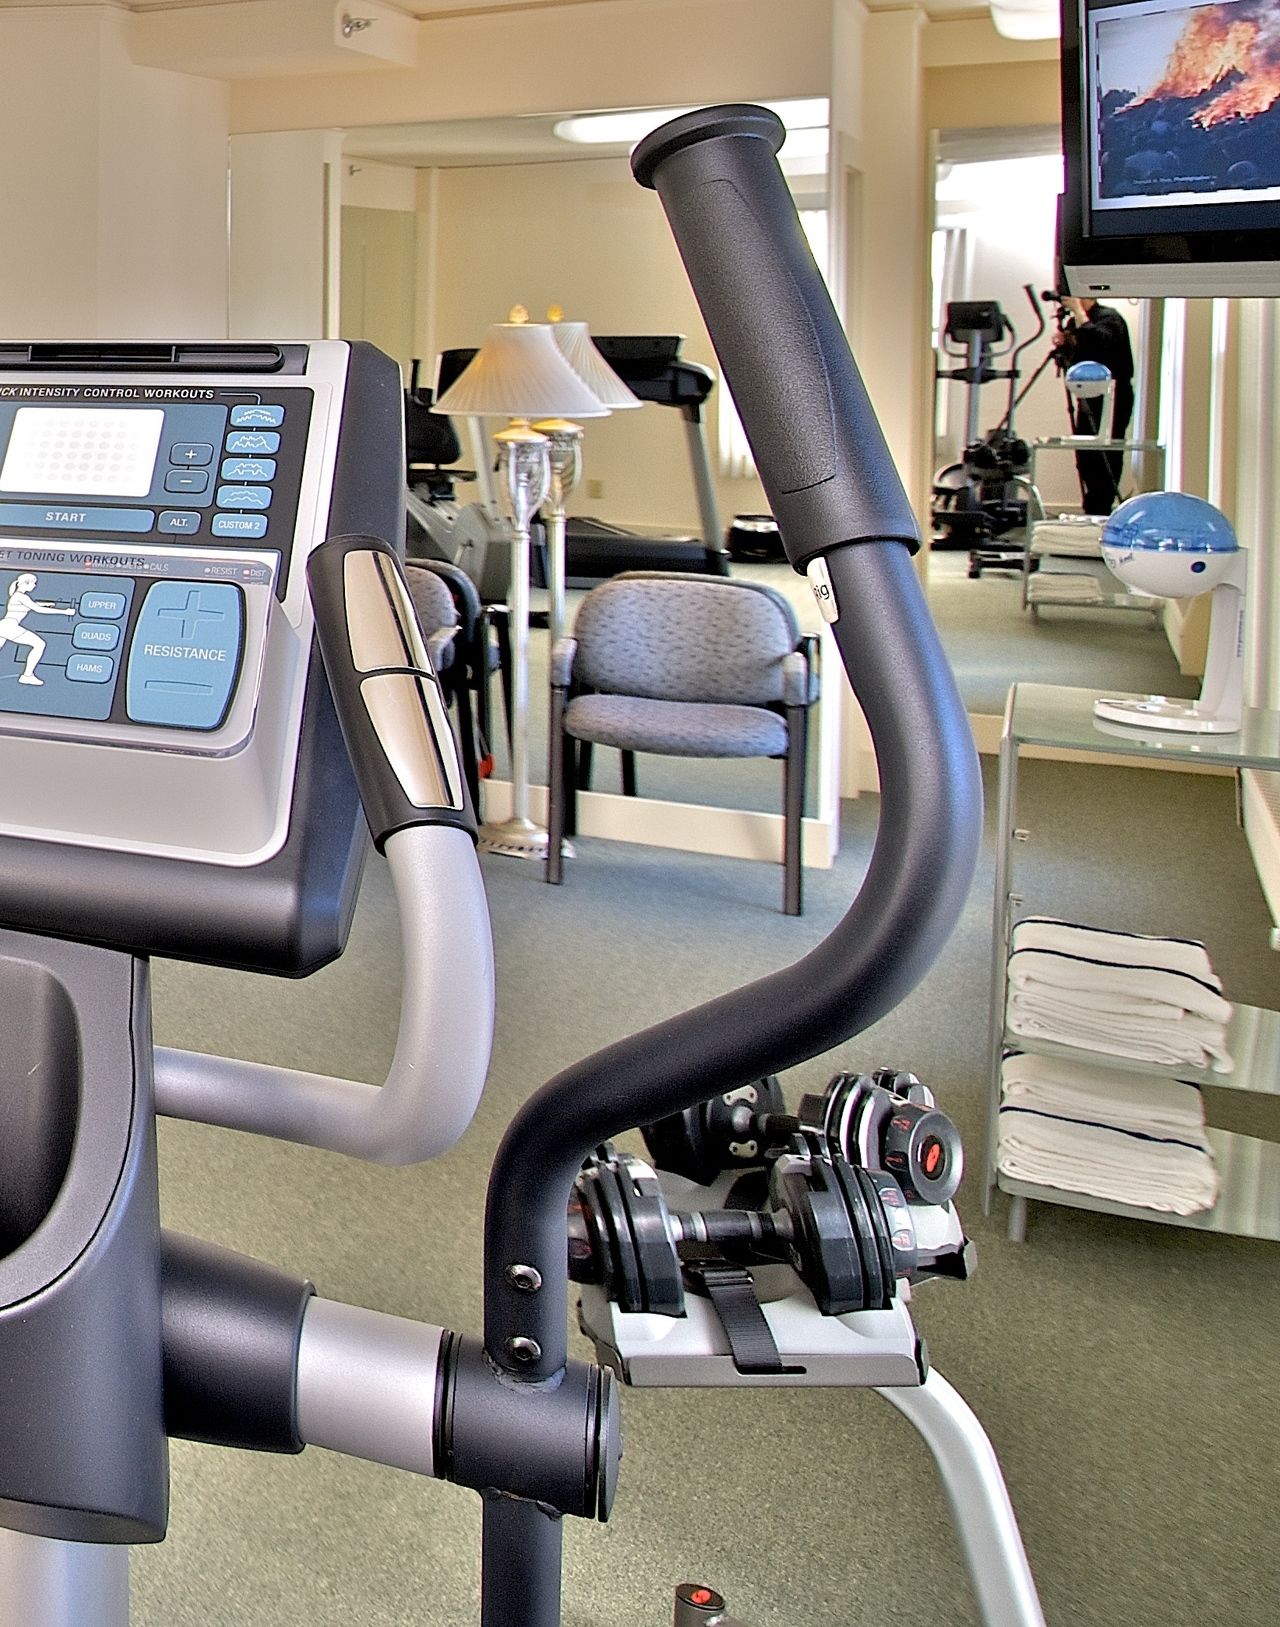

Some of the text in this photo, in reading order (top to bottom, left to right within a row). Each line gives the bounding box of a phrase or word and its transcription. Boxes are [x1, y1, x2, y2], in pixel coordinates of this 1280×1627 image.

[18, 388, 80, 398] INTENSITY
[83, 388, 140, 399] CONTROL
[144, 389, 215, 399] WORKOUTS
[45, 511, 87, 522] START
[170, 517, 189, 527] ALT.
[218, 520, 261, 531] CUSTOM 2
[16, 550, 65, 562] TONING
[70, 553, 145, 567] WORKOUTS
[149, 562, 169, 571] CALS
[211, 566, 238, 576] RESIST
[251, 568, 267, 578] DIST
[88, 600, 117, 610] UPPER
[81, 631, 112, 641] QUADS
[143, 644, 227, 662] RESISTANCE
[76, 663, 103, 673] HAMS
